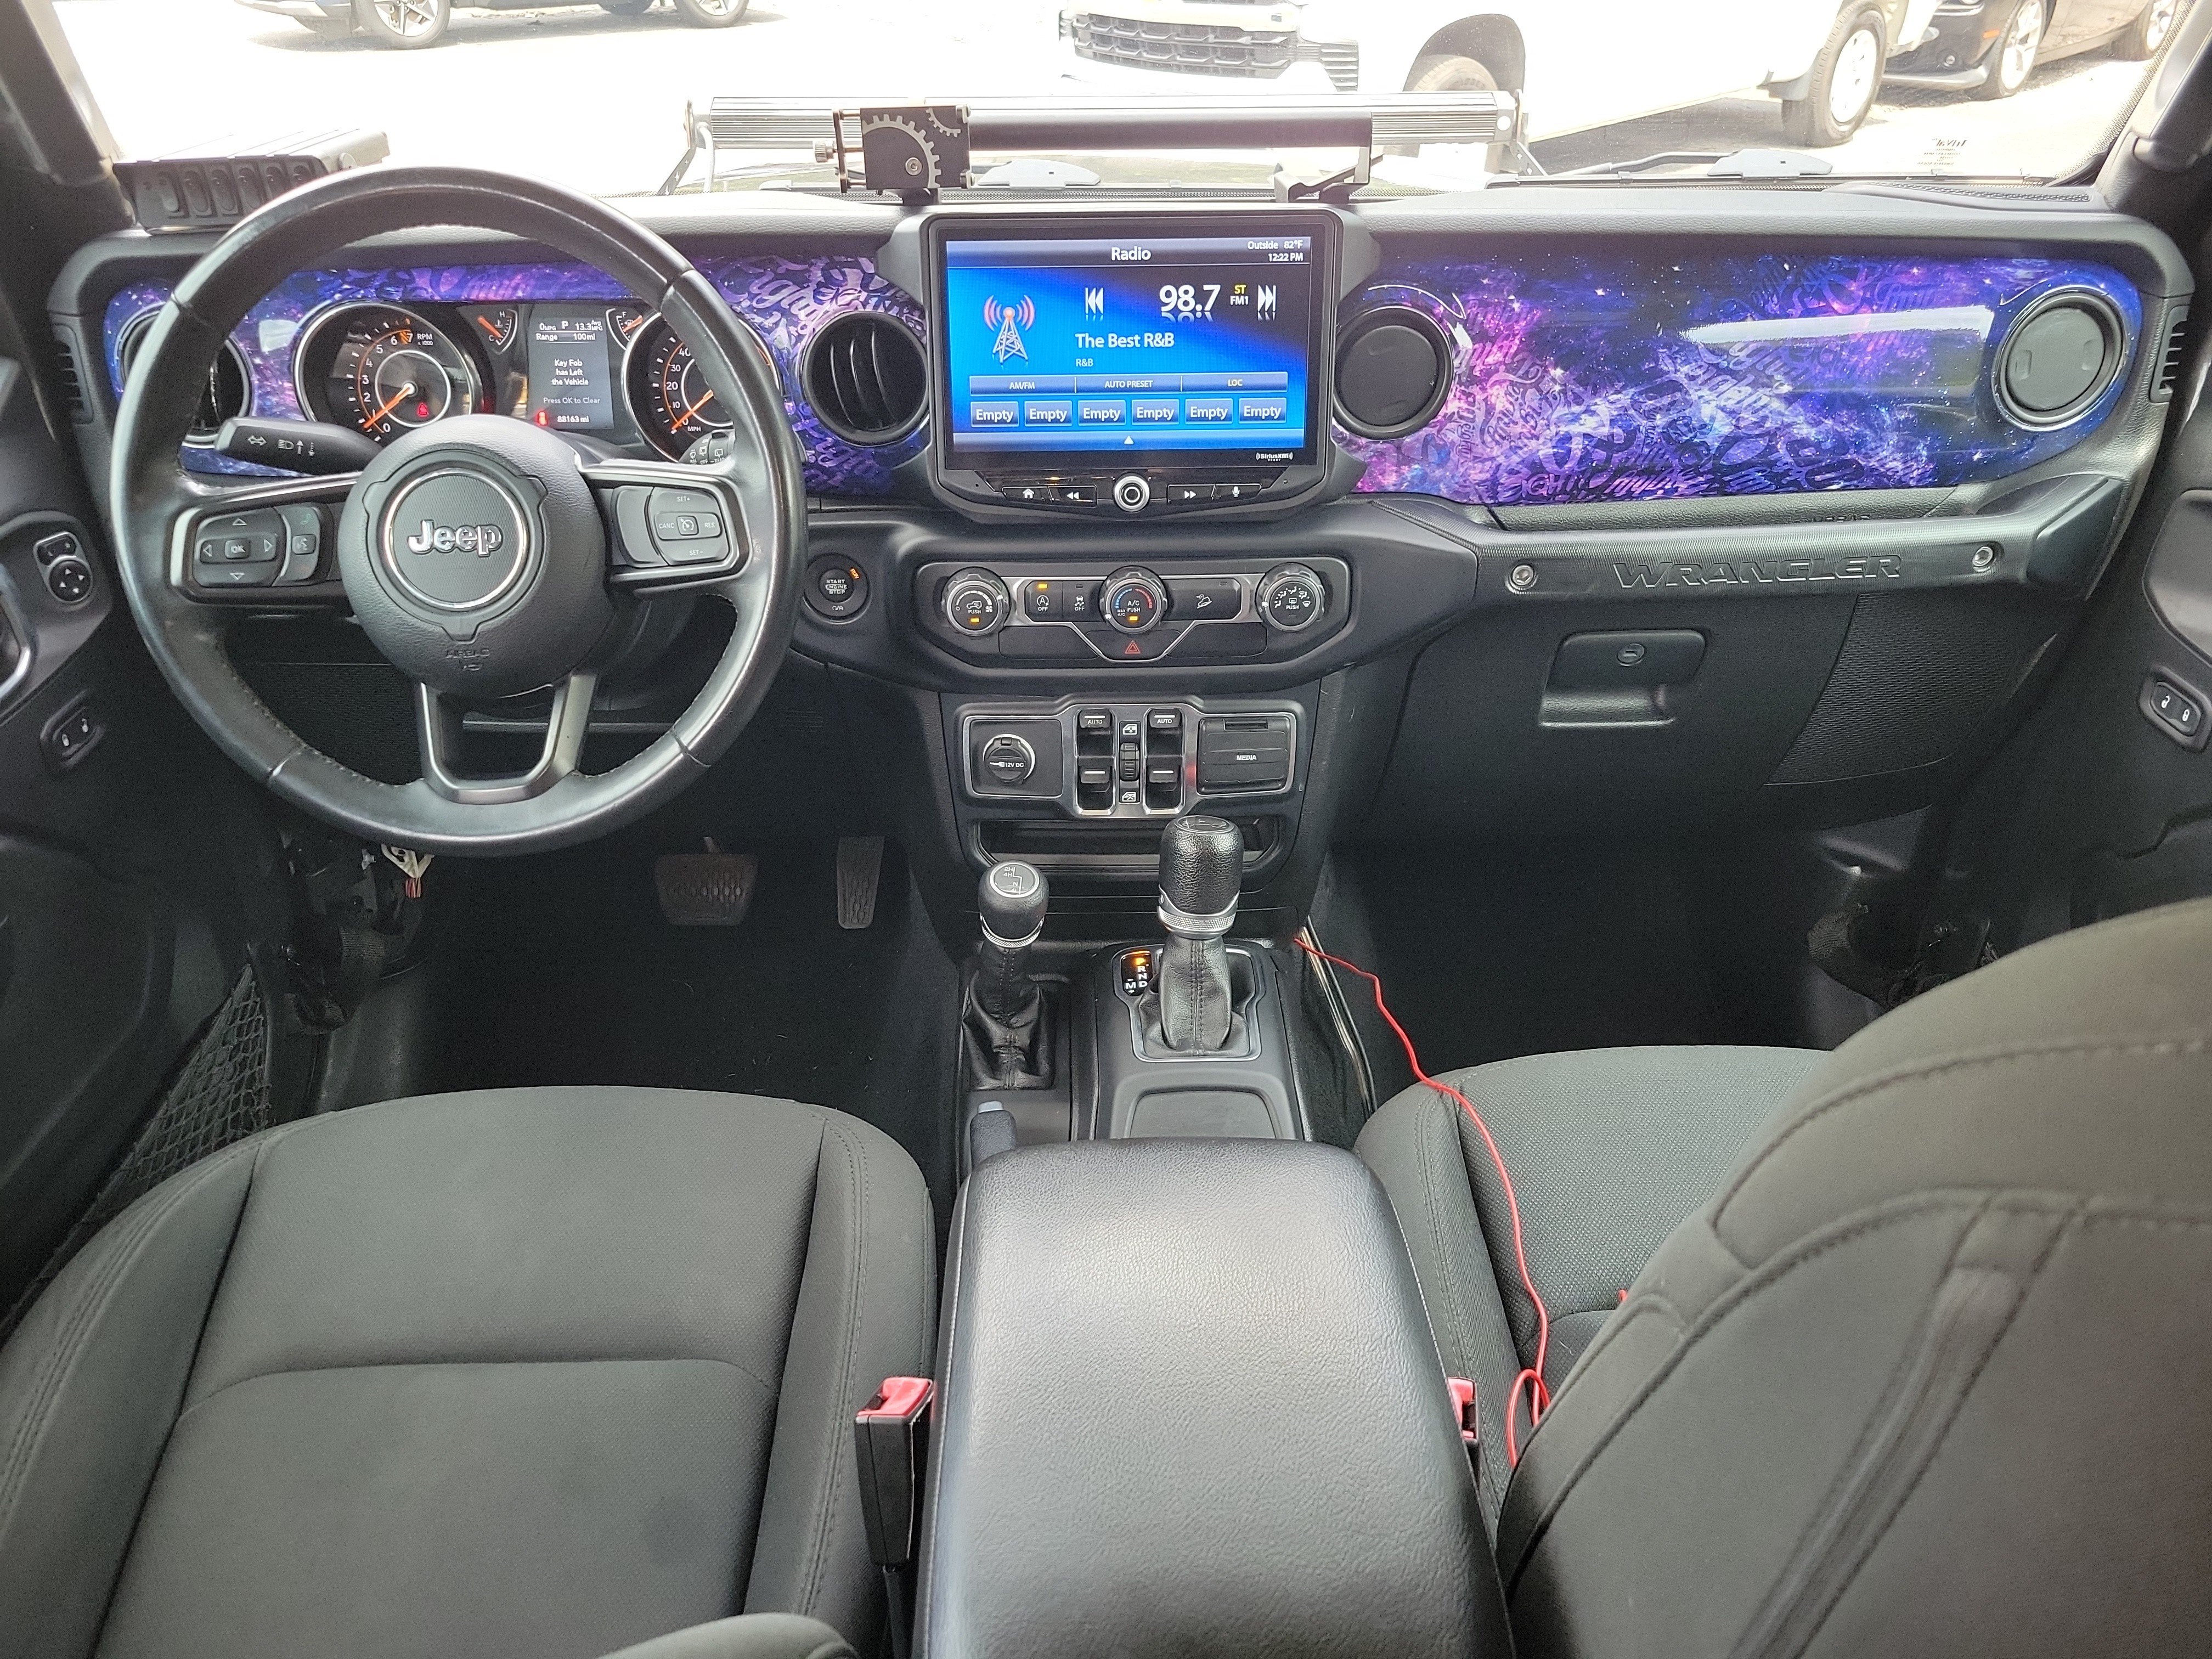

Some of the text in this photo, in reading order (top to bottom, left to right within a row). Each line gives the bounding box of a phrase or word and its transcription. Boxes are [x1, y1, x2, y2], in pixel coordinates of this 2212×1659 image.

[1247, 240, 1303, 250] Outside 82°F
[1111, 246, 1152, 261] Radio
[1268, 253, 1303, 262] 12:22 PM
[1234, 285, 1246, 294] ST
[1159, 284, 1221, 313] 98.7
[1230, 295, 1249, 306] FM1
[562, 321, 569, 329] P
[576, 323, 591, 331] 13.3
[391, 336, 398, 346] 6
[408, 333, 414, 342] 7
[1074, 332, 1175, 348] The Best R&B
[376, 344, 383, 354] 5
[365, 358, 374, 368] 4
[554, 359, 567, 368] Key
[1075, 358, 1093, 367] R&B
[362, 375, 369, 385] 3
[666, 382, 679, 390] 20
[1009, 382, 1035, 390] AM/FM
[364, 392, 371, 402] 2
[975, 409, 1014, 423] Empty
[1029, 408, 1067, 422] Empty
[1083, 408, 1121, 421] Empty
[1137, 407, 1175, 421] Empty
[1190, 406, 1228, 420] Empty
[1244, 405, 1282, 419] Empty
[382, 423, 391, 433] 0
[407, 519, 504, 557] Jeep
[1613, 554, 1902, 588] WRANGLER
[1136, 957, 1146, 966] P
[1125, 981, 1137, 990] M
